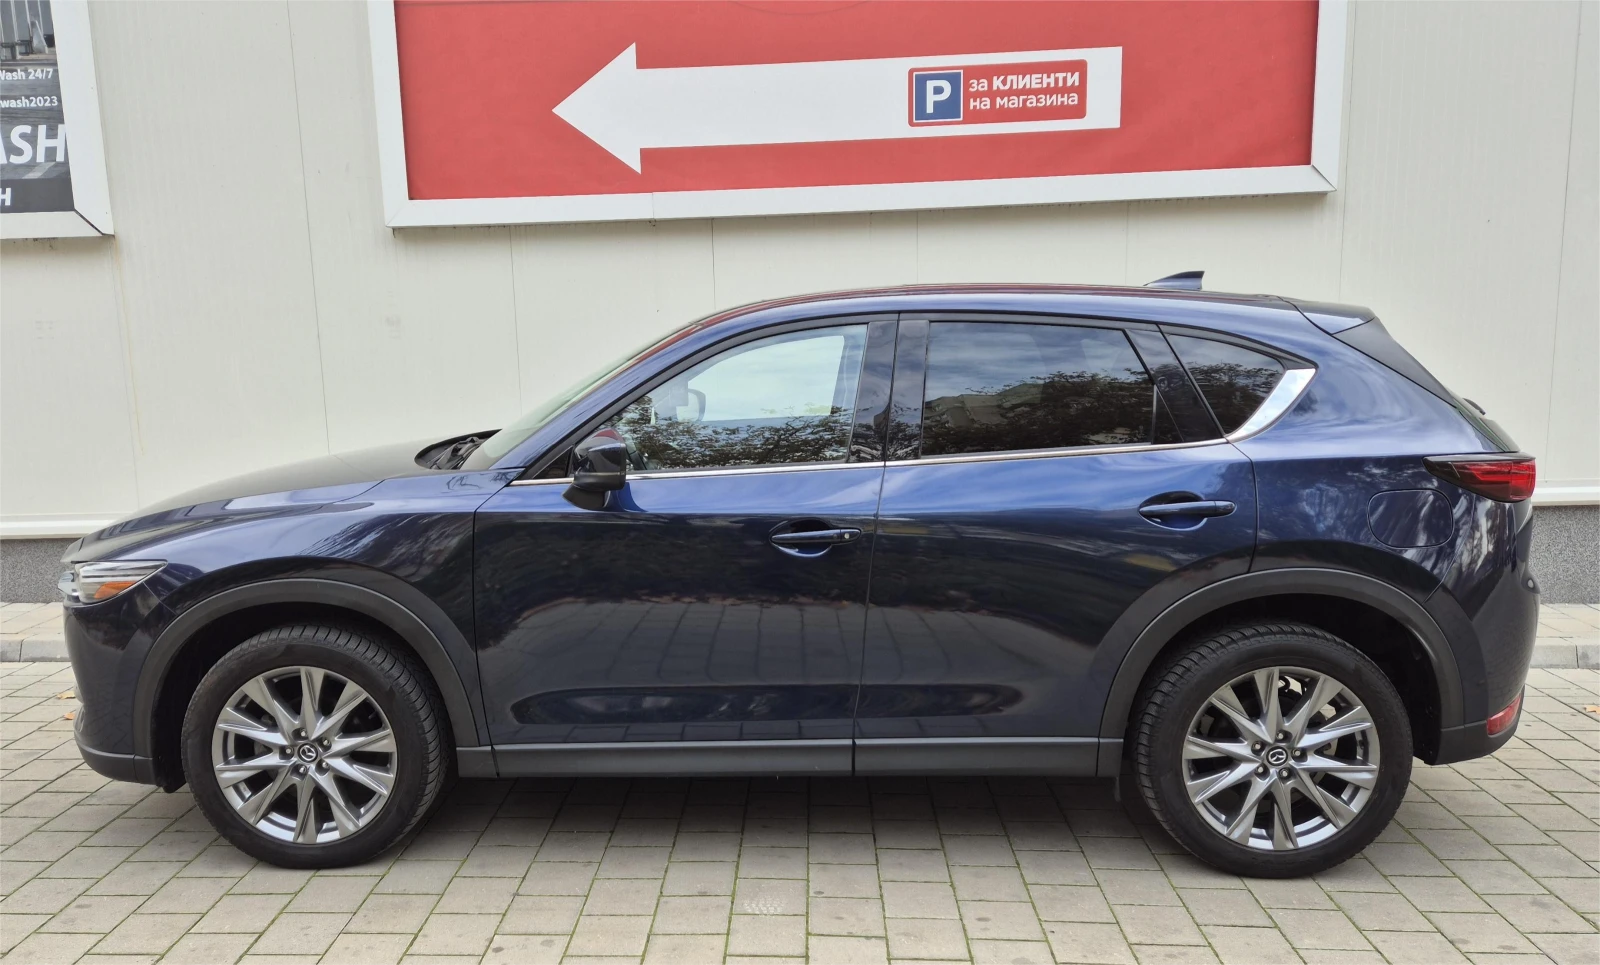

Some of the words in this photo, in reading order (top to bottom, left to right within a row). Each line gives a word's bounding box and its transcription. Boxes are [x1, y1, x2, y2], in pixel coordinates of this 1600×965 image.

[28, 68, 53, 79] 24/7
[969, 79, 988, 92] за
[992, 72, 1080, 91] КЛИЕНТИ
[926, 79, 951, 113] P
[969, 97, 991, 110] на
[996, 92, 1079, 109] магазина
[0, 124, 66, 164] SH
